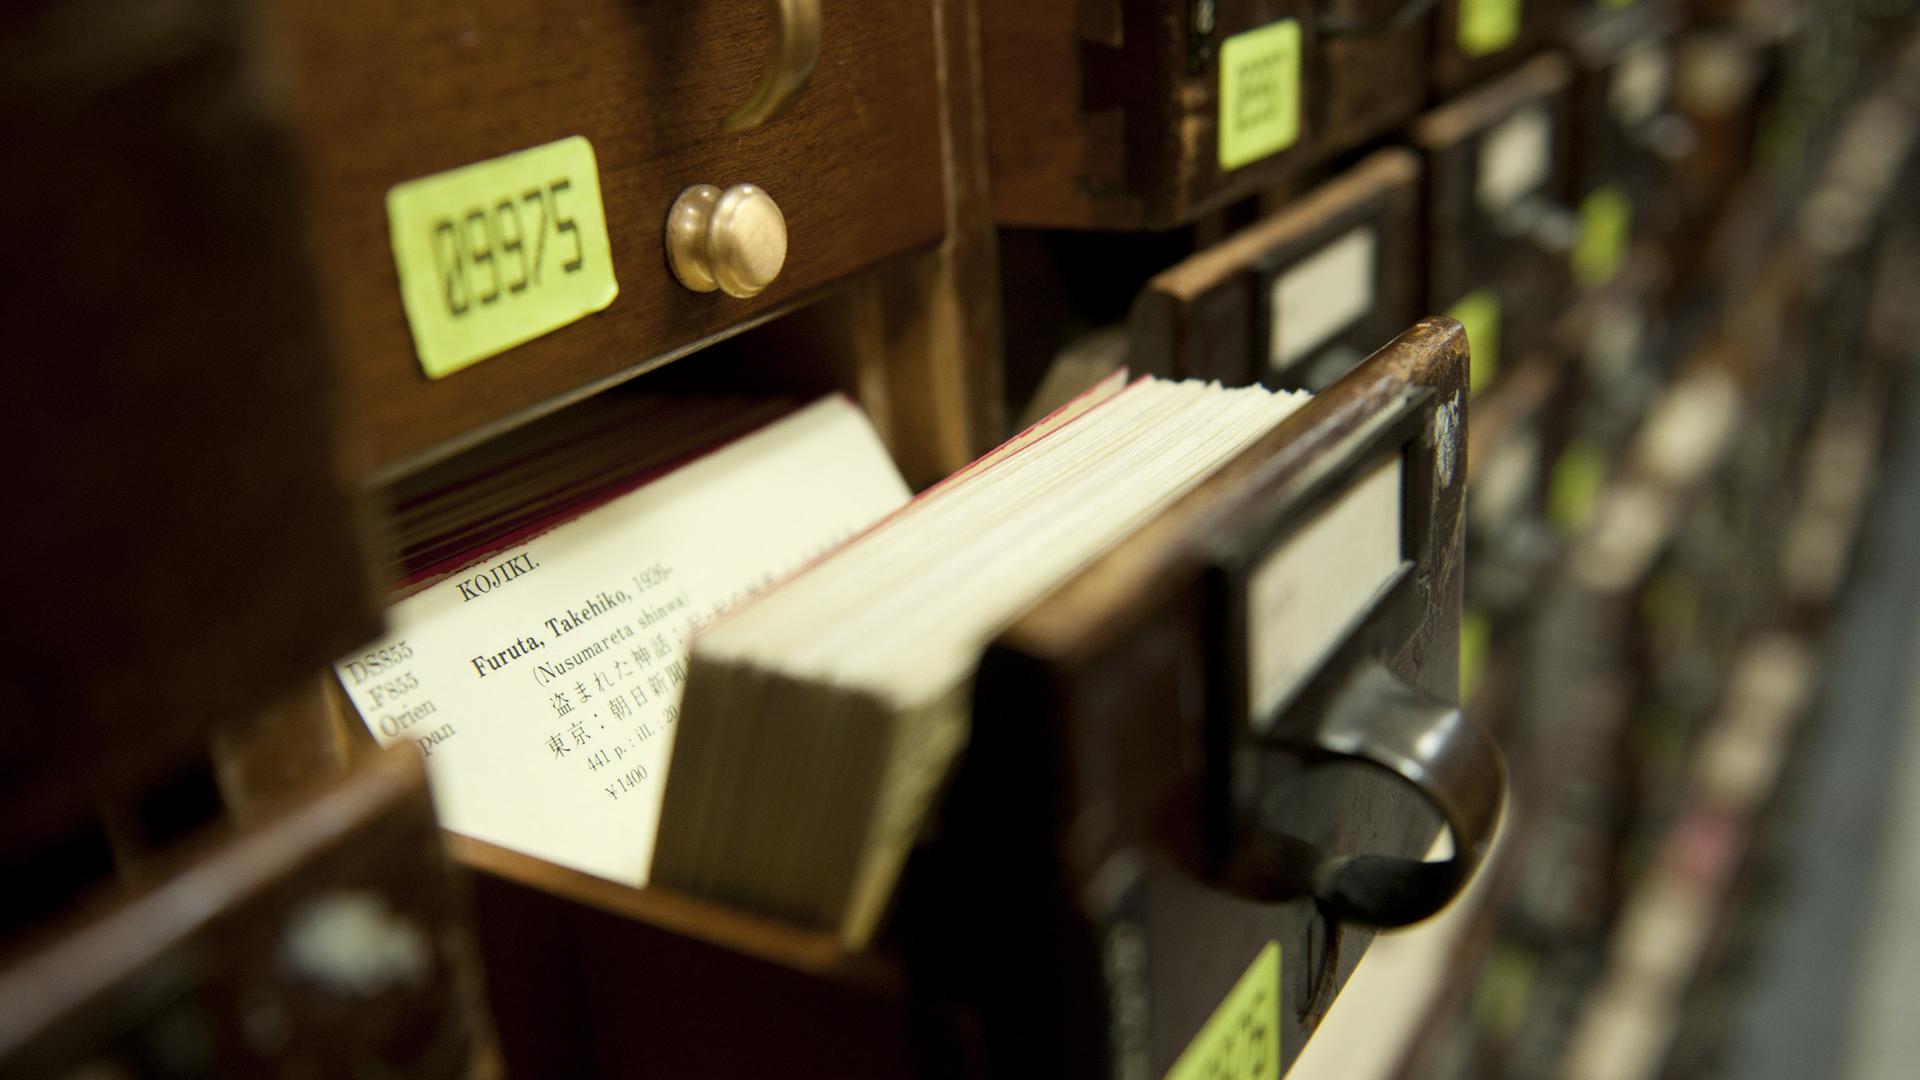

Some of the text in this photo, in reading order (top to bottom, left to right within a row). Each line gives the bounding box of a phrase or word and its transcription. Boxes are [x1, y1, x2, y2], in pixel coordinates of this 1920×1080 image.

[432, 178, 582, 317] 09975
[456, 552, 540, 602] KOJIKI.
[470, 636, 545, 678] Furuta,
[544, 590, 632, 638] Takehiko,
[533, 623, 634, 687] (Nusumareta
[344, 640, 413, 684] DS855
[379, 700, 437, 737] Orien
[586, 749, 611, 771] 441
